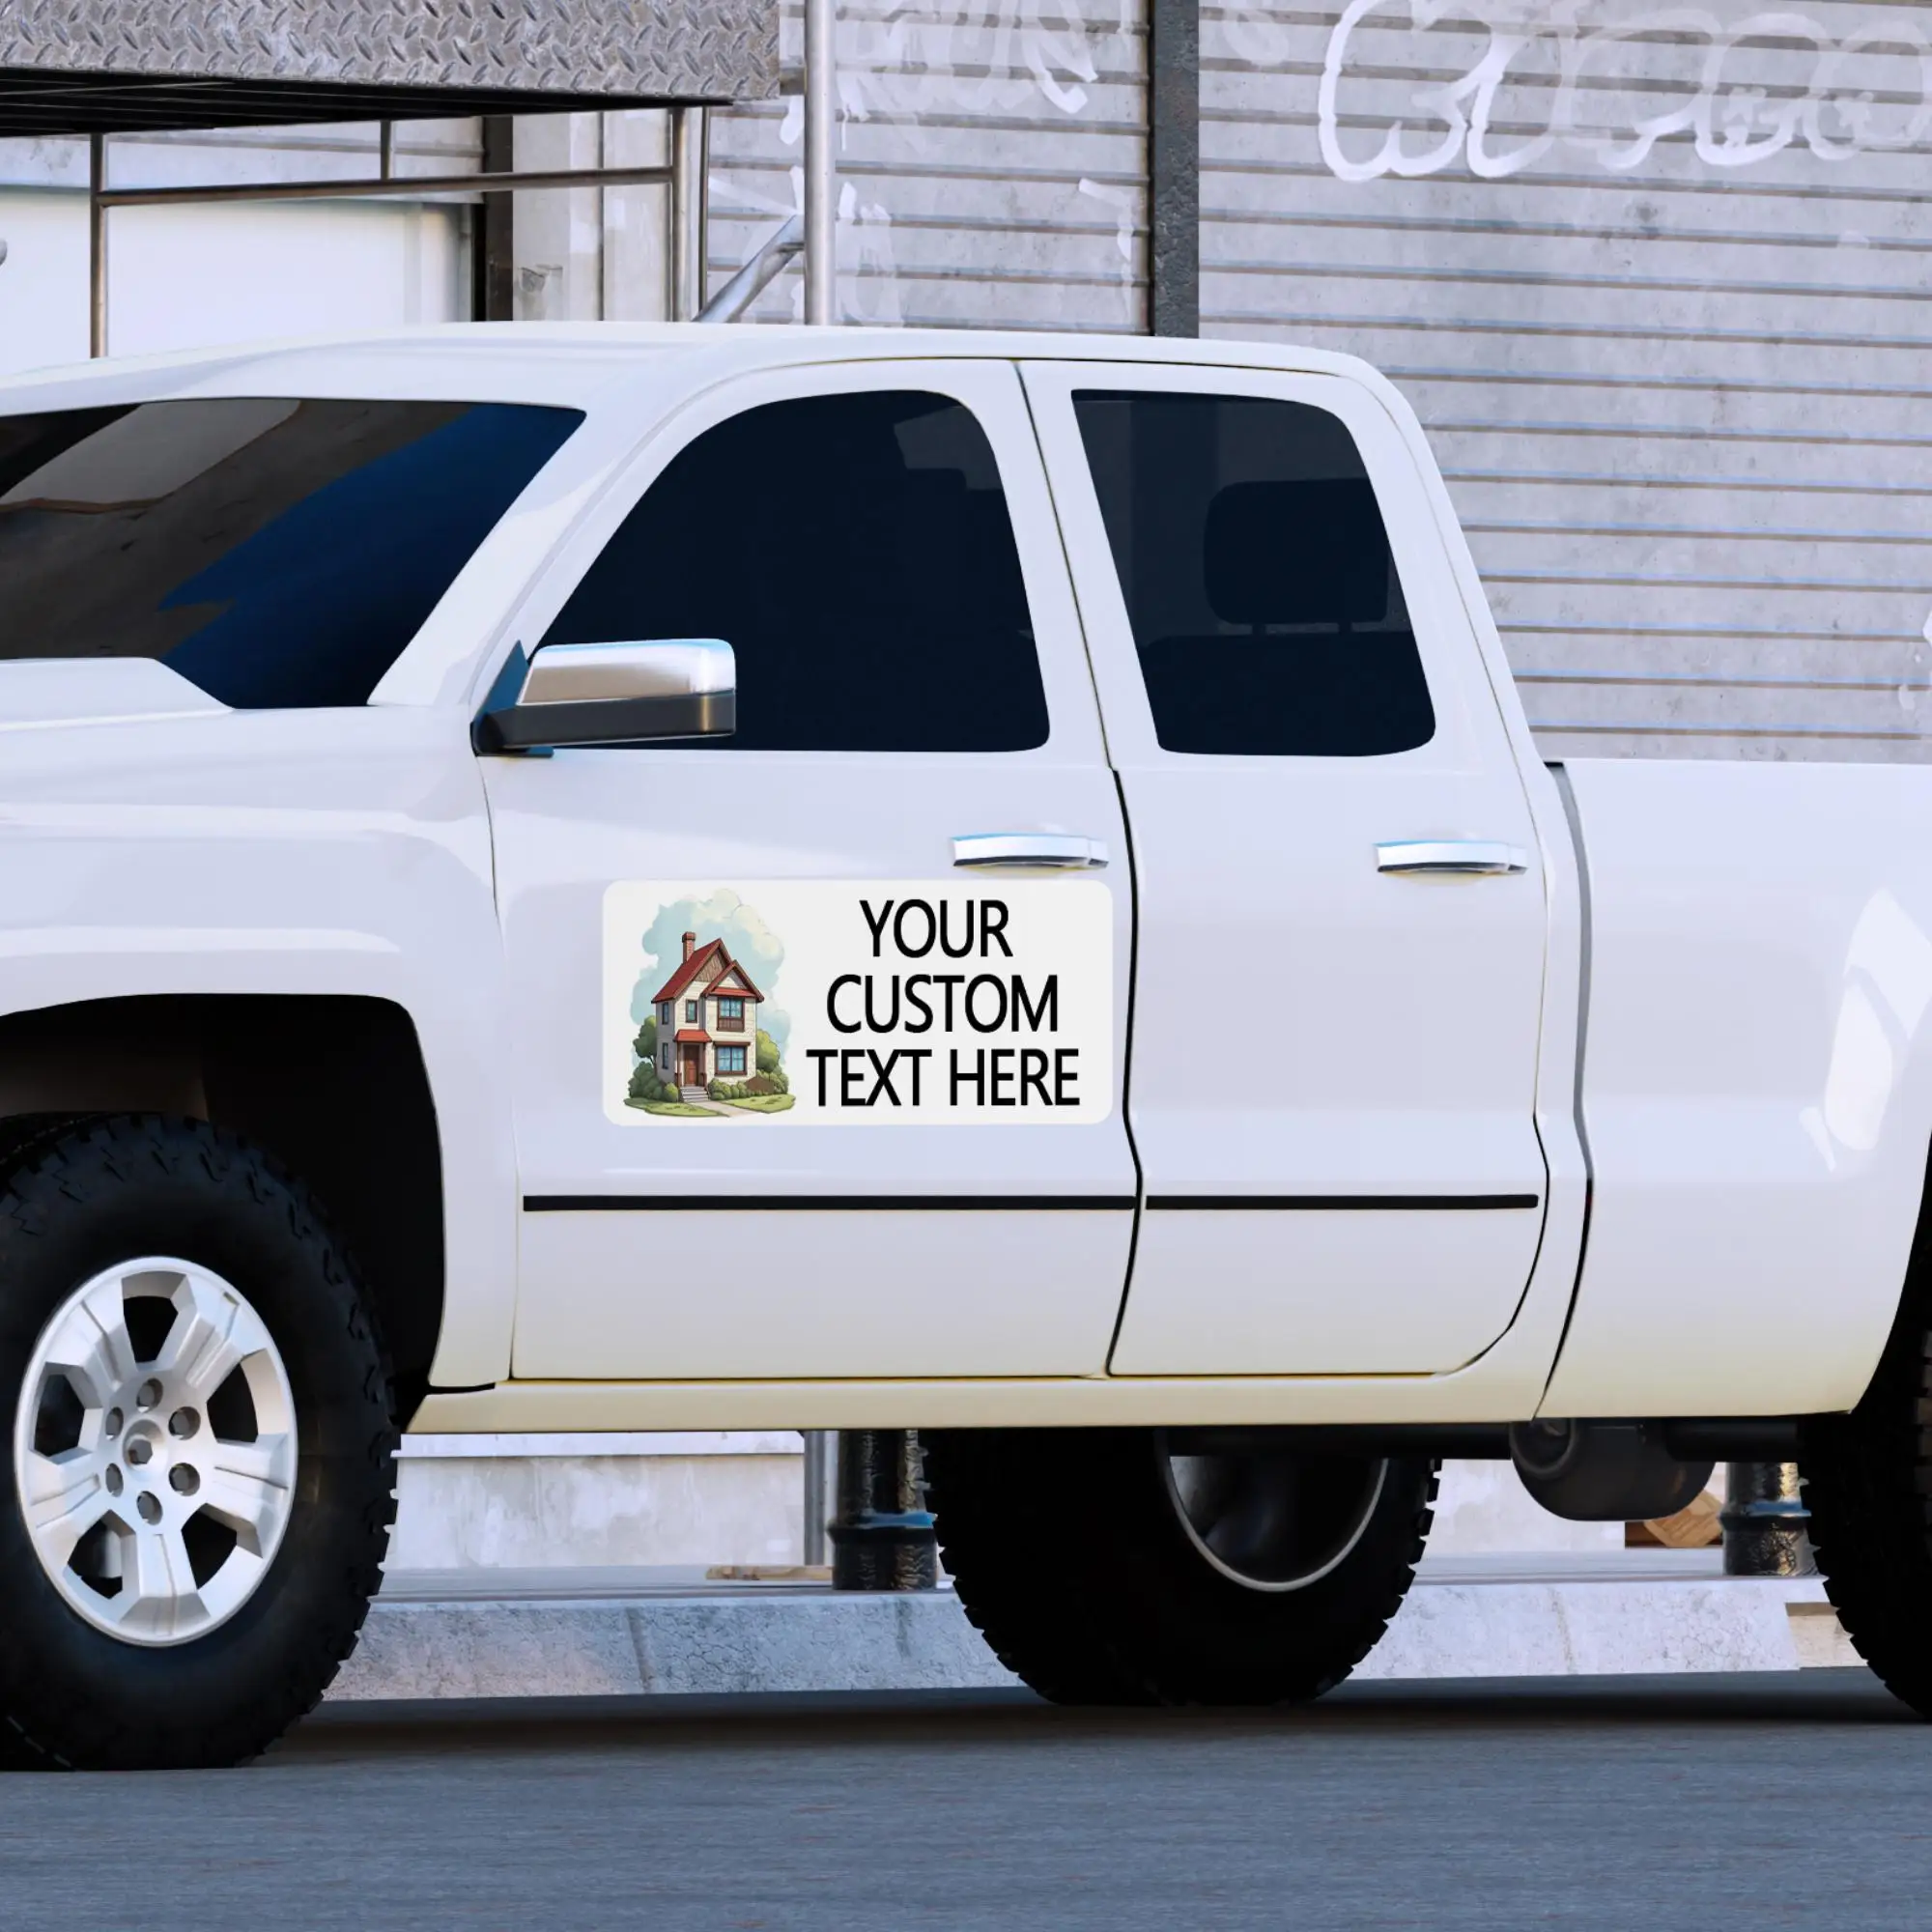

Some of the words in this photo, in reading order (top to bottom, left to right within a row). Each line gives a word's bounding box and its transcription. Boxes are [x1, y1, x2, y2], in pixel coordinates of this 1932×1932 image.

[859, 898, 1013, 958] YOUR
[826, 974, 1058, 1034] CUSTOM
[806, 1048, 932, 1107] TEXT
[950, 1048, 1080, 1107] HERE
